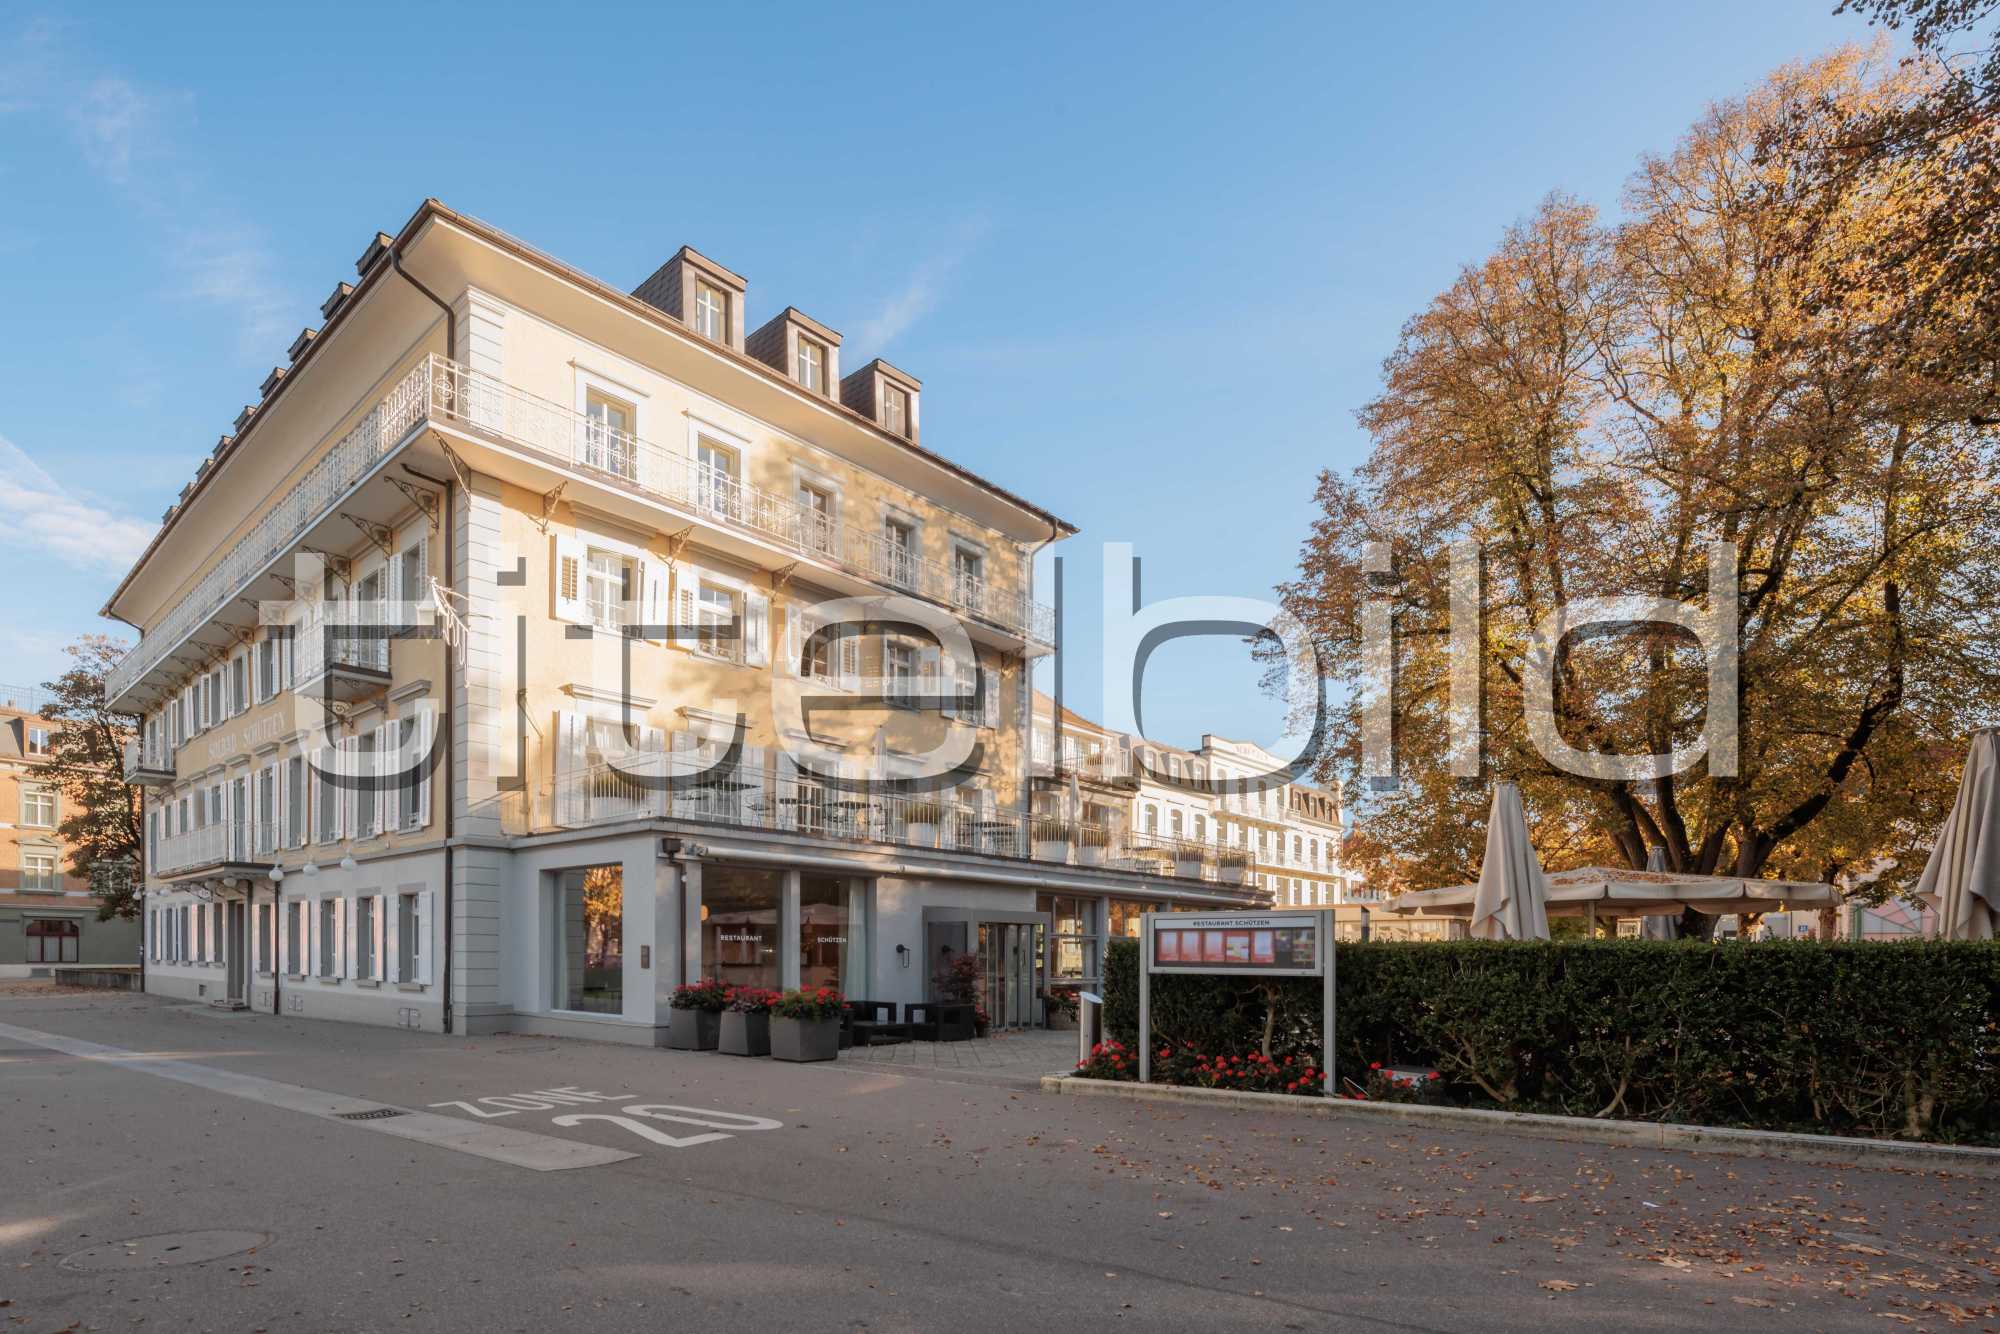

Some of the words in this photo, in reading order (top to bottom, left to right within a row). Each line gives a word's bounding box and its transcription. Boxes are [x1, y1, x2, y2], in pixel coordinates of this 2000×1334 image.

[720, 934, 762, 942] RESTAURANT
[428, 1086, 639, 1118] ZONE
[551, 1104, 784, 1148] 20
